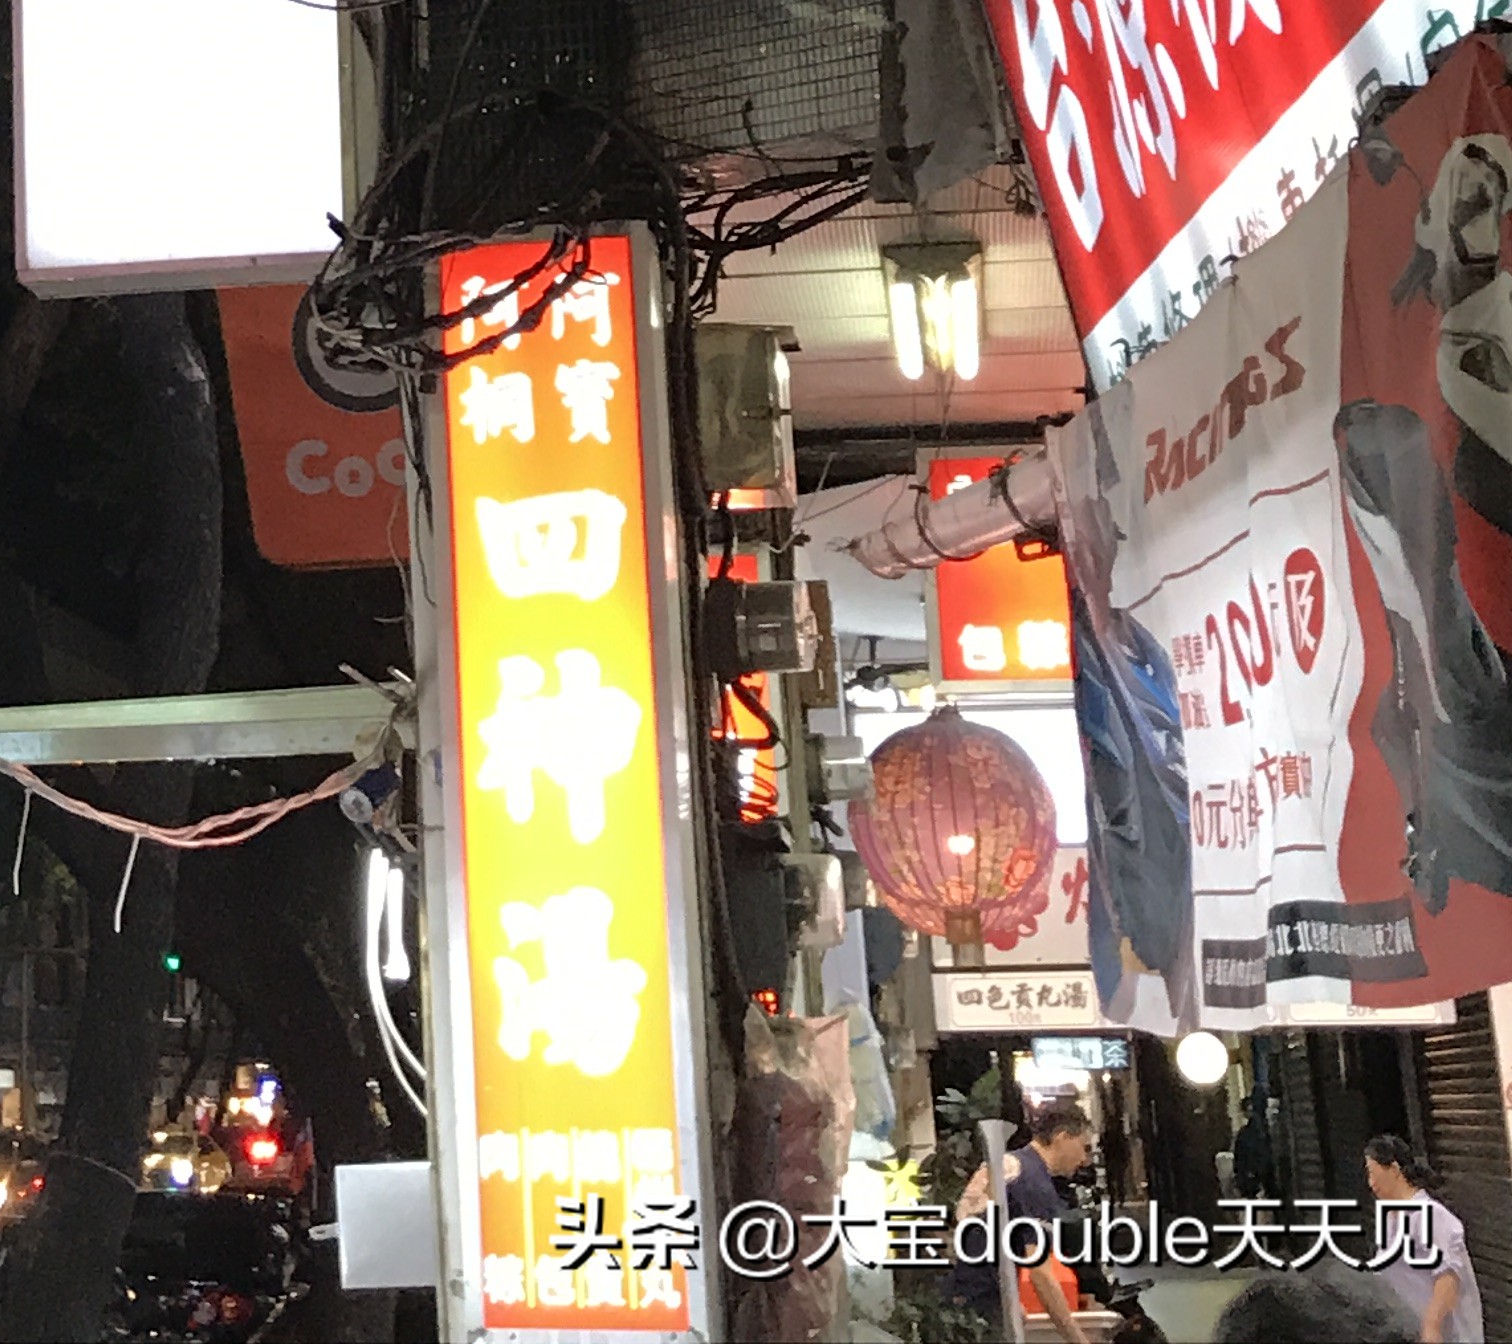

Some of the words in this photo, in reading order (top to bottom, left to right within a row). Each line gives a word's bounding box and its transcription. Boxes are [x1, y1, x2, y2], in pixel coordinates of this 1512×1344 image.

[955, 980, 1089, 1012] 四色貢丸湯
